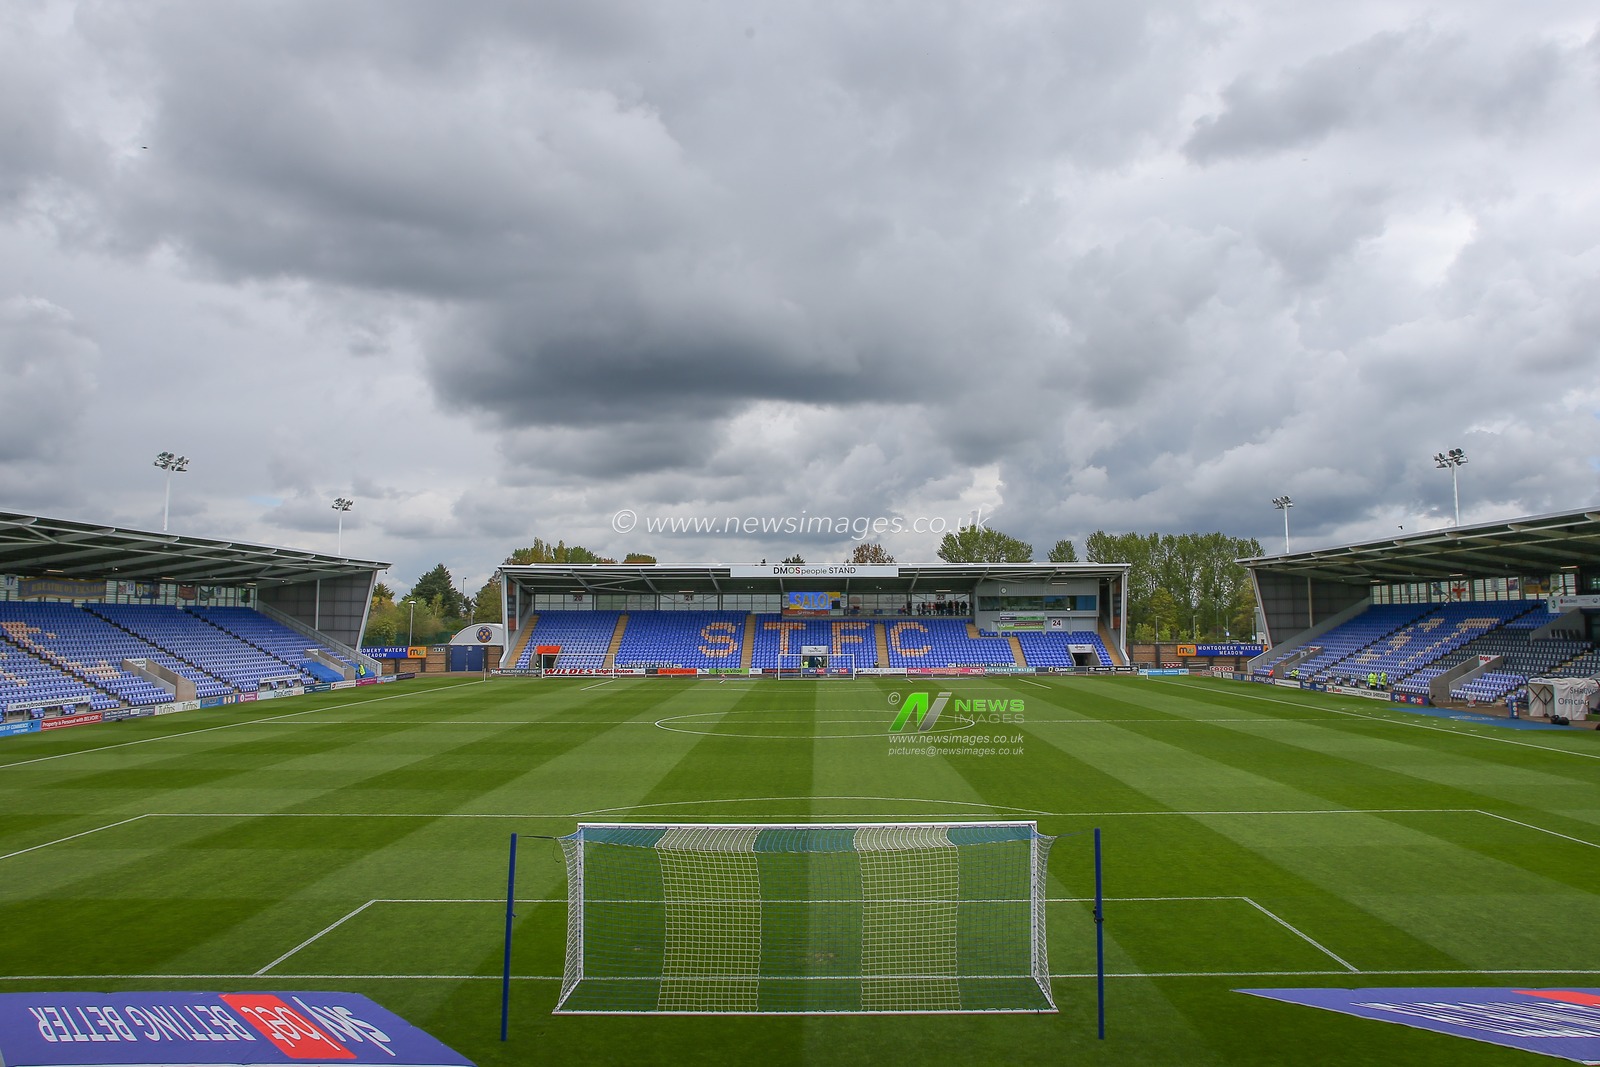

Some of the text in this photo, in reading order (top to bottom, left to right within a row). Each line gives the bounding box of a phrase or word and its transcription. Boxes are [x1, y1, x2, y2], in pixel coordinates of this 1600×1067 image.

[828, 566, 857, 575] STAND
[1052, 619, 1061, 627] 24
[595, 668, 613, 676] Bright
[42, 720, 58, 728] Property
[27, 1006, 138, 1042] BETTER
[124, 1005, 257, 1041] BETTING
